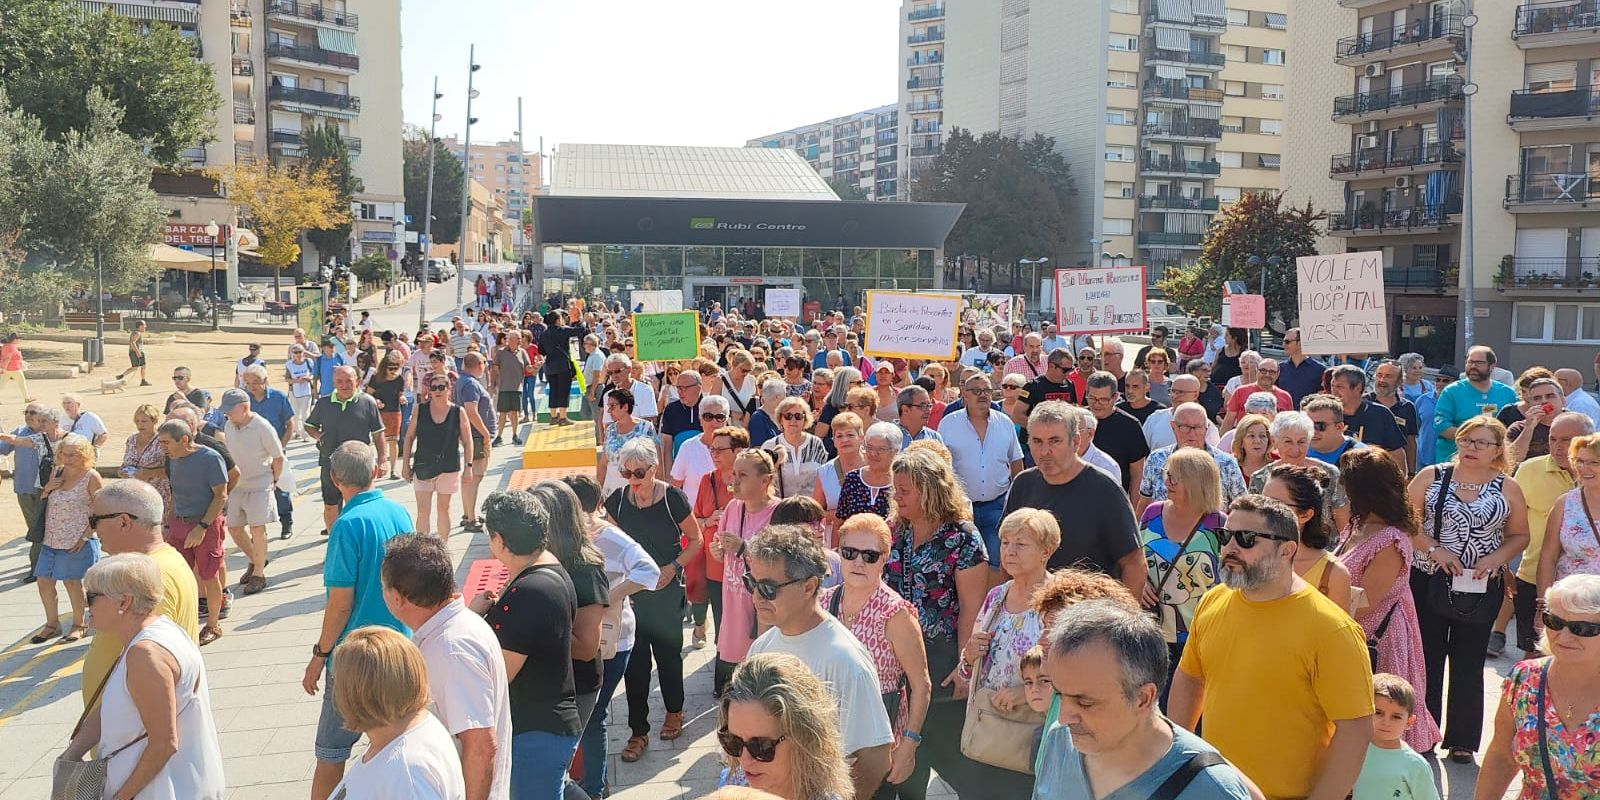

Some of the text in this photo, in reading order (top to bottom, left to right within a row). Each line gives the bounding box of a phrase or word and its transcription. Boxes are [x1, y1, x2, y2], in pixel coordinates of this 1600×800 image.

[165, 225, 187, 234] BAR
[756, 222, 807, 231] Centre
[164, 235, 218, 244] DEL TREN
[1301, 257, 1378, 283] VOLEM
[1329, 284, 1346, 292] UN
[1299, 291, 1385, 311] HOSPITAL
[1331, 313, 1345, 322] DE
[1303, 323, 1384, 341] VERITAT
